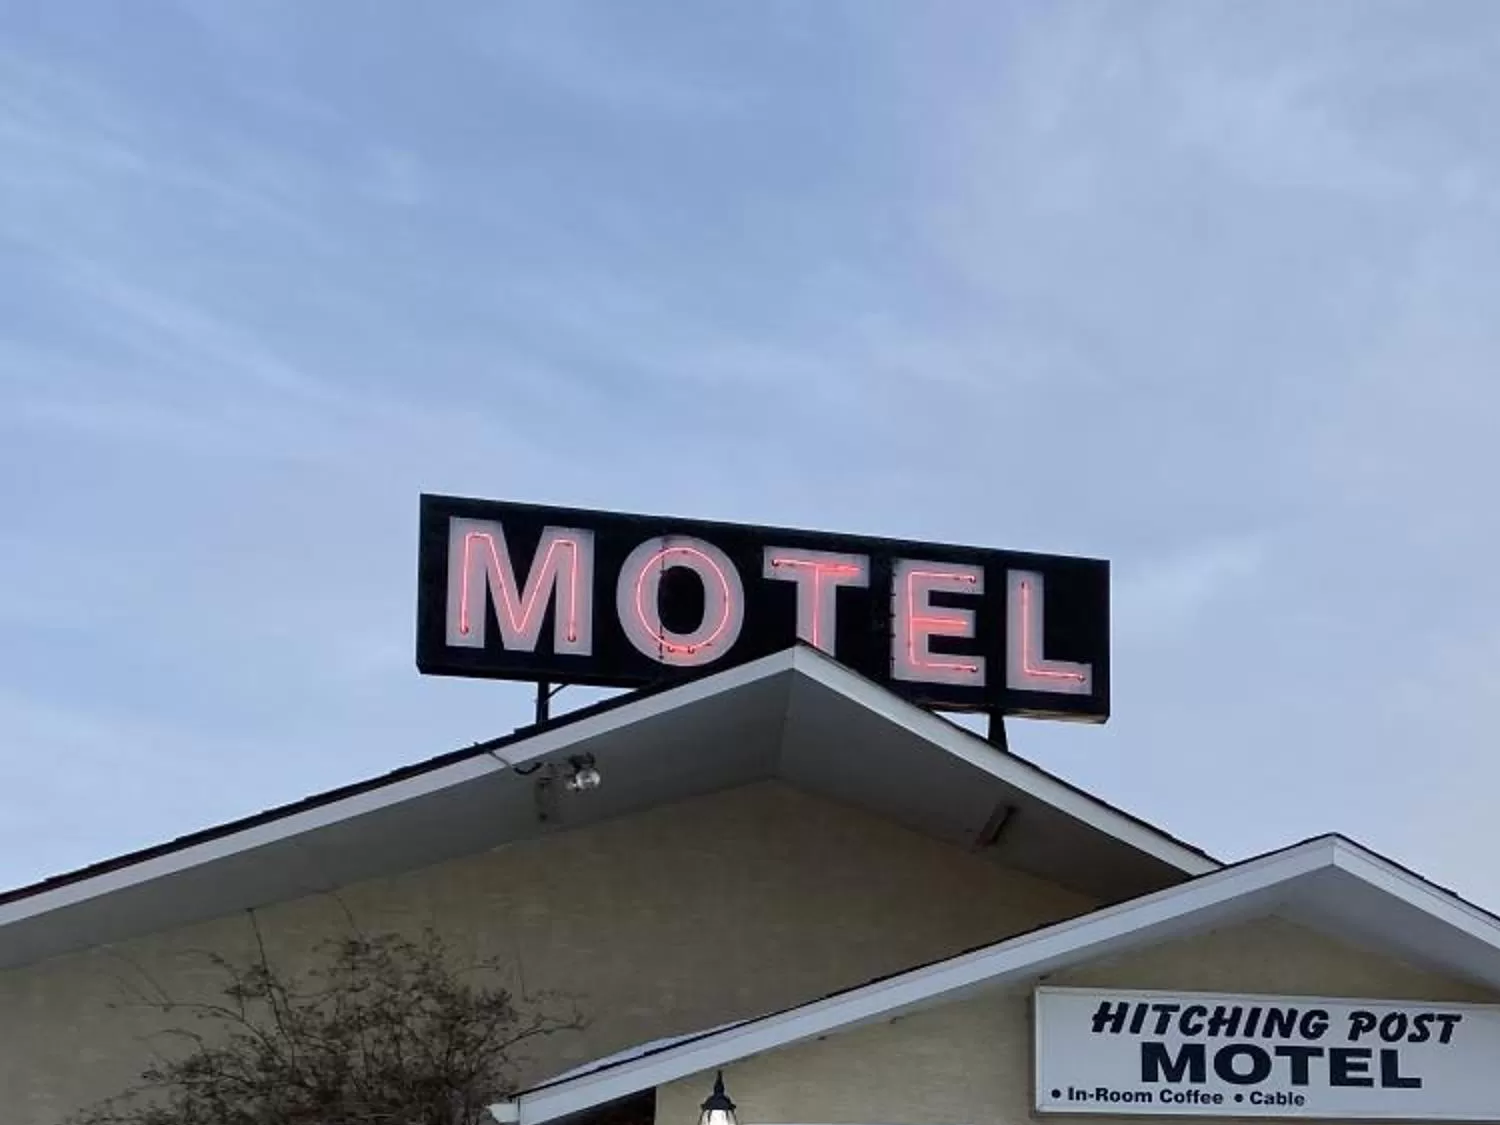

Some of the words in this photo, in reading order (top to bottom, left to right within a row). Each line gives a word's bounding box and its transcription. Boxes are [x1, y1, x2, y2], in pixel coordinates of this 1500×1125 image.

[446, 516, 1094, 694] MOTEL
[1092, 1001, 1330, 1040] HITCHING
[1347, 1010, 1463, 1045] POST
[1141, 1042, 1423, 1090] MOTEL
[1068, 1087, 1153, 1103] In-Room
[1159, 1089, 1225, 1105] Coffee
[1249, 1091, 1306, 1107] Cable
